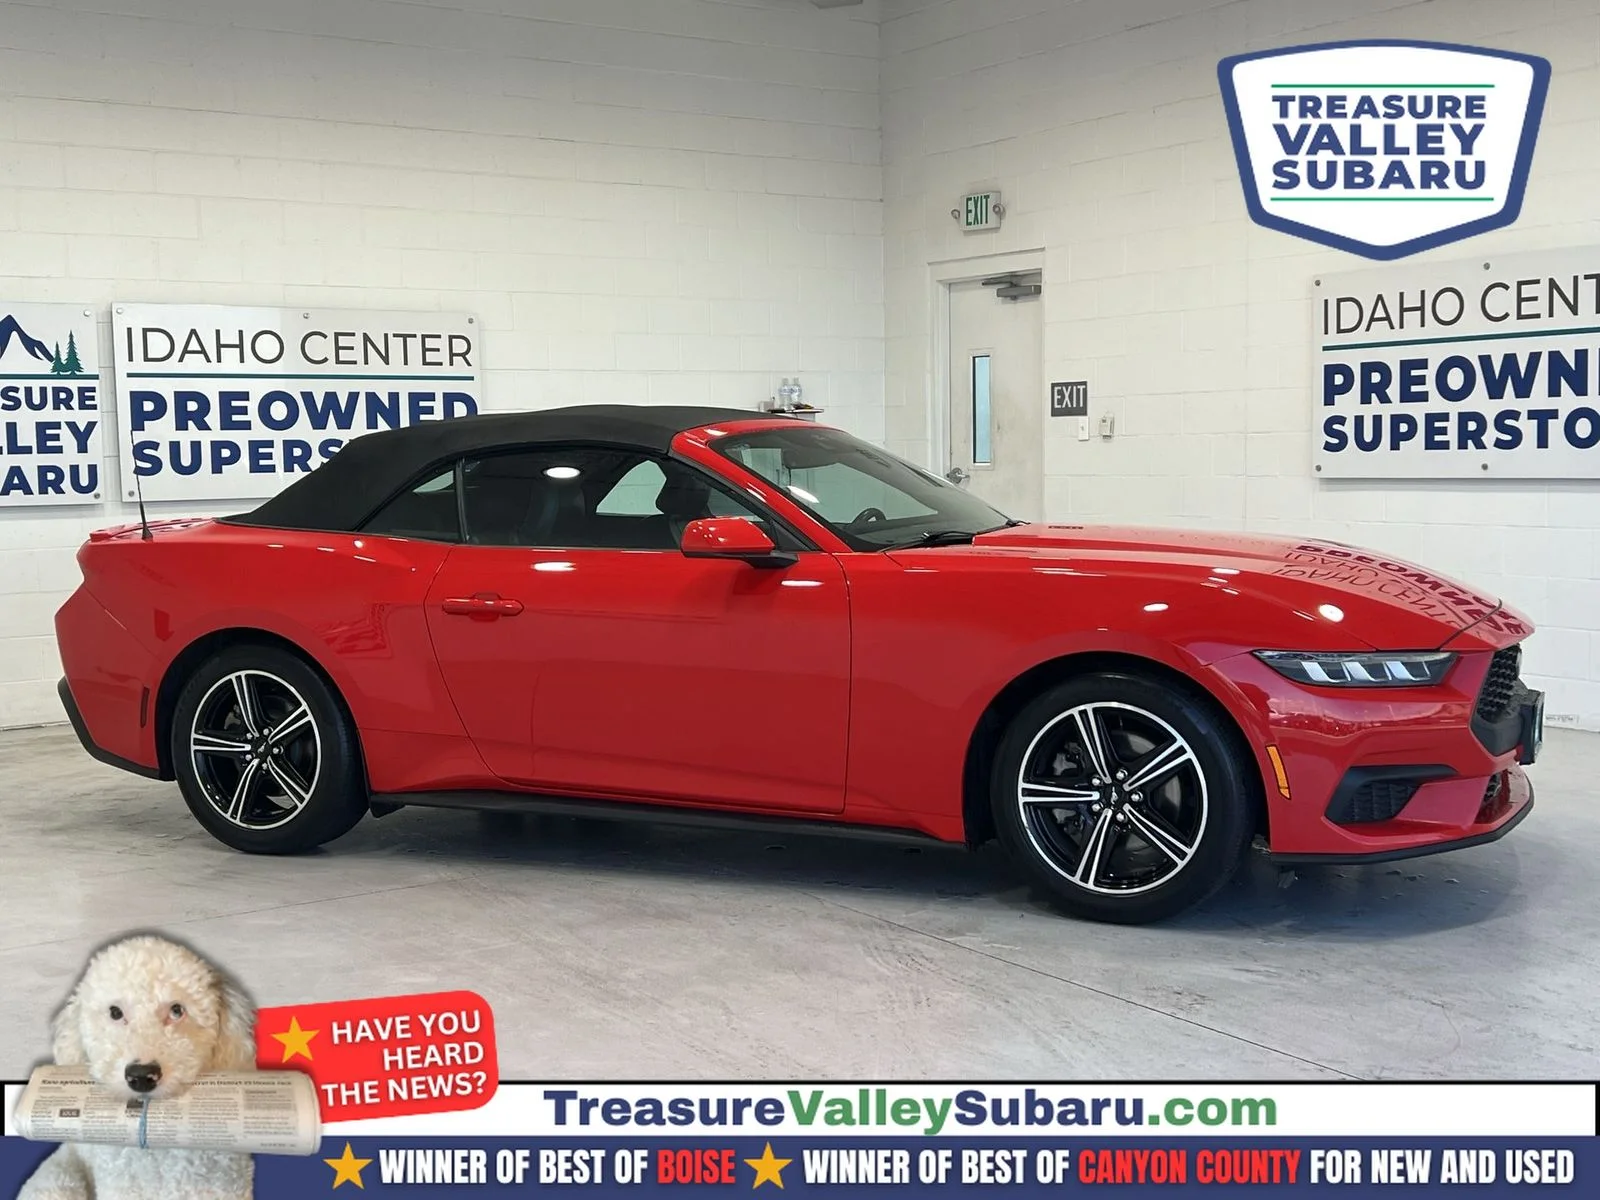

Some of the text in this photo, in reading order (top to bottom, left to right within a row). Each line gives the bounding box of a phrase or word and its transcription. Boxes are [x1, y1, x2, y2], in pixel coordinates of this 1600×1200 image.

[965, 194, 990, 226] EXIT
[1323, 287, 1465, 335] IDAHO
[126, 326, 473, 367] IDAHO CENTER
[0, 385, 98, 411] SURE
[129, 389, 478, 431] PREOWNED
[1053, 385, 1086, 409] EXIT
[1322, 406, 1600, 452] SUPERSTO
